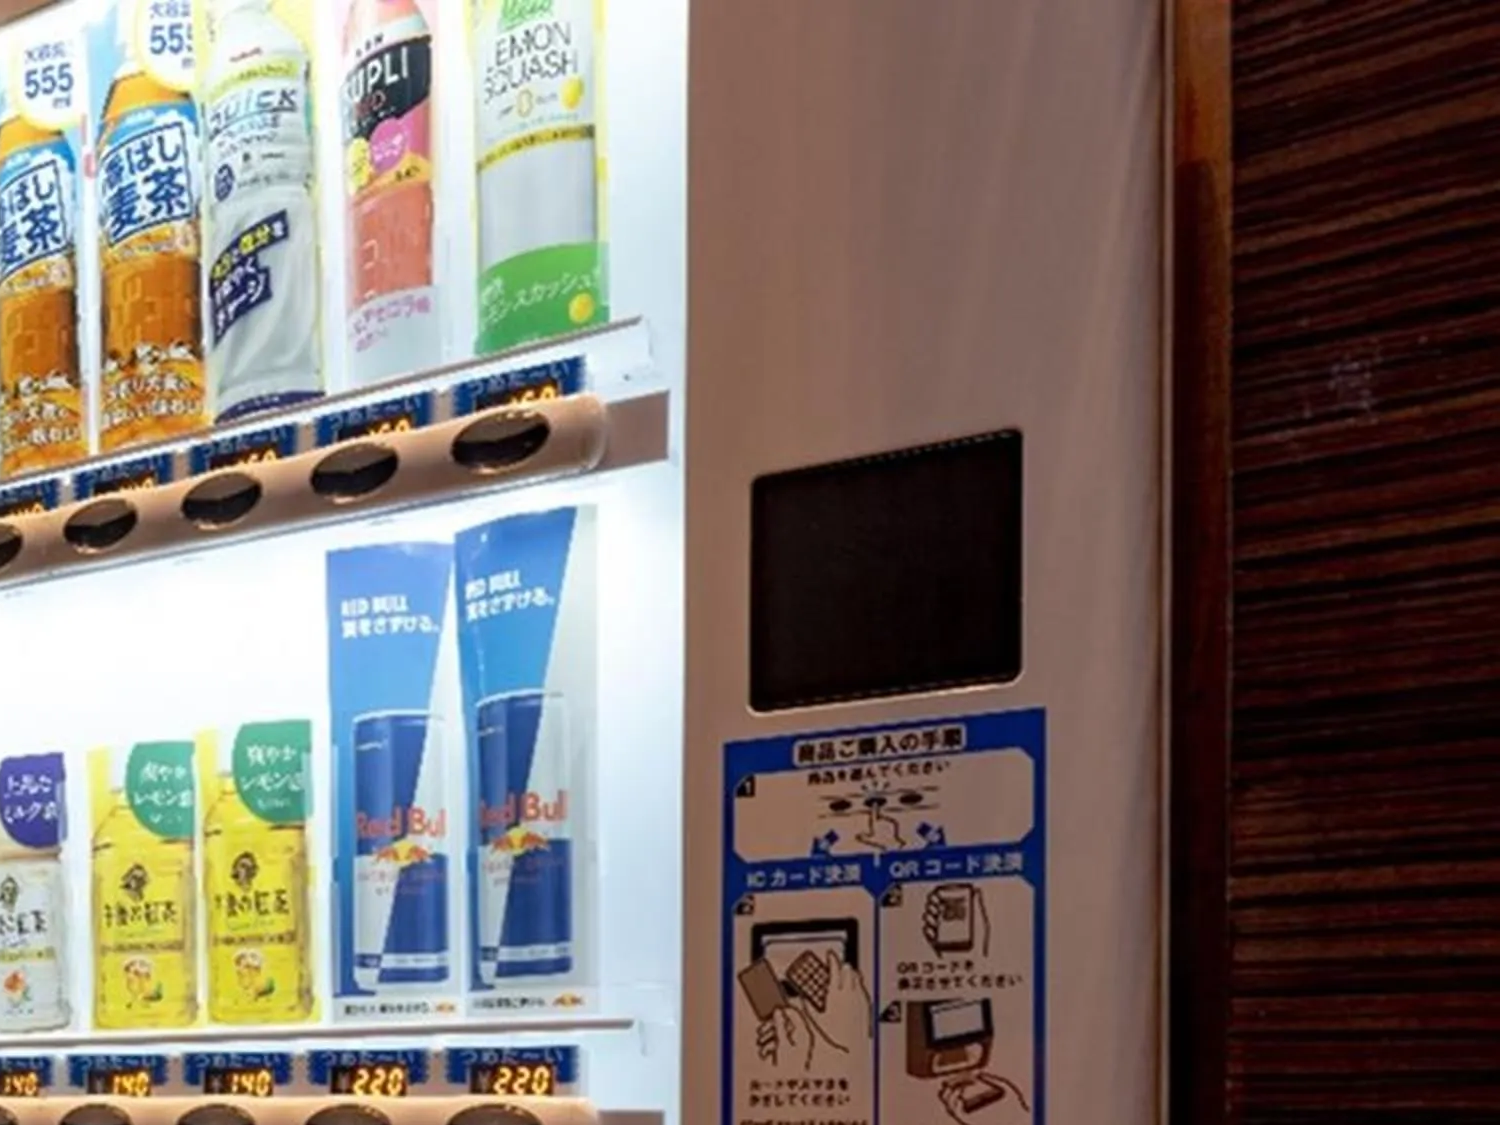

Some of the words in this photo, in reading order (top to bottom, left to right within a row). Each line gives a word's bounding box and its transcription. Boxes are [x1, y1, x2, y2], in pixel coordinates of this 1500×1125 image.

[24, 63, 75, 99] 555
[523, 788, 568, 822] Bul
[408, 807, 446, 838] Bul
[4, 1073, 38, 1096] 140
[112, 1072, 149, 1096] 140
[231, 1070, 272, 1096] 140
[353, 1067, 403, 1096] 220
[493, 1065, 551, 1095] 220
